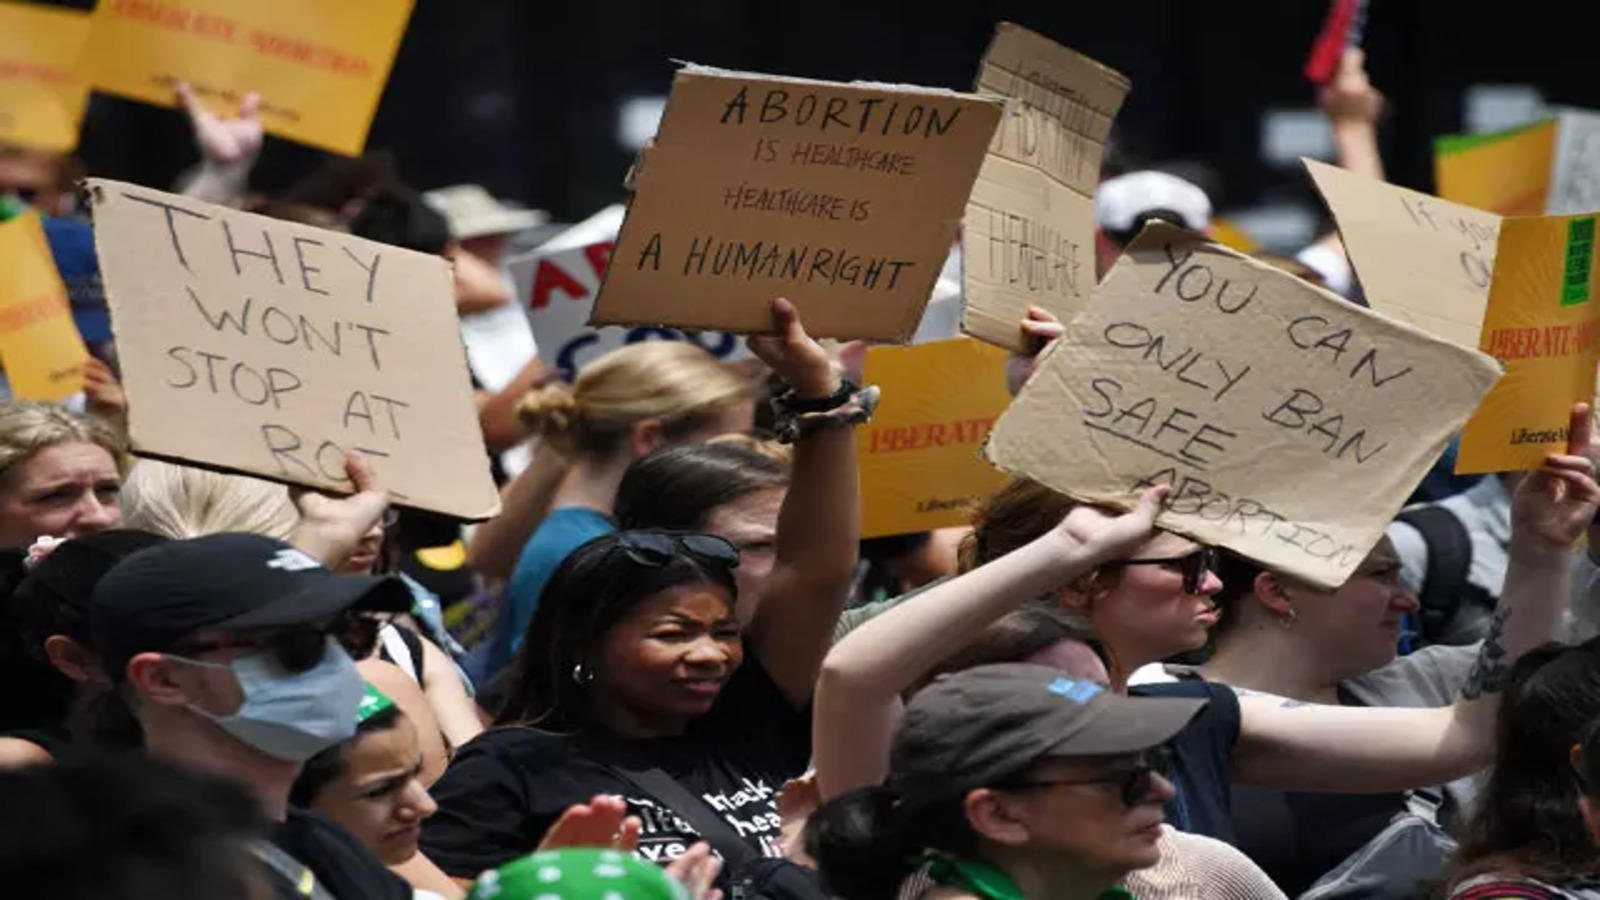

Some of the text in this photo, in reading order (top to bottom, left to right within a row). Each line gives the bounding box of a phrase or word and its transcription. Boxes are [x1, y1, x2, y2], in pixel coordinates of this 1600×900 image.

[720, 86, 961, 137] ABORTION
[753, 139, 918, 176] IS HEALTHCARE
[723, 182, 870, 221] HEALTHCARE IS
[121, 192, 382, 303] THEY
[637, 232, 663, 272] A
[186, 286, 390, 370] WON'T
[1154, 243, 1413, 388] YOU CAN
[166, 346, 410, 441] STOP AT
[1083, 378, 1238, 464] SAFE
[1104, 321, 1389, 466] ONLY BAN
[1129, 467, 1357, 568] ABORTION
